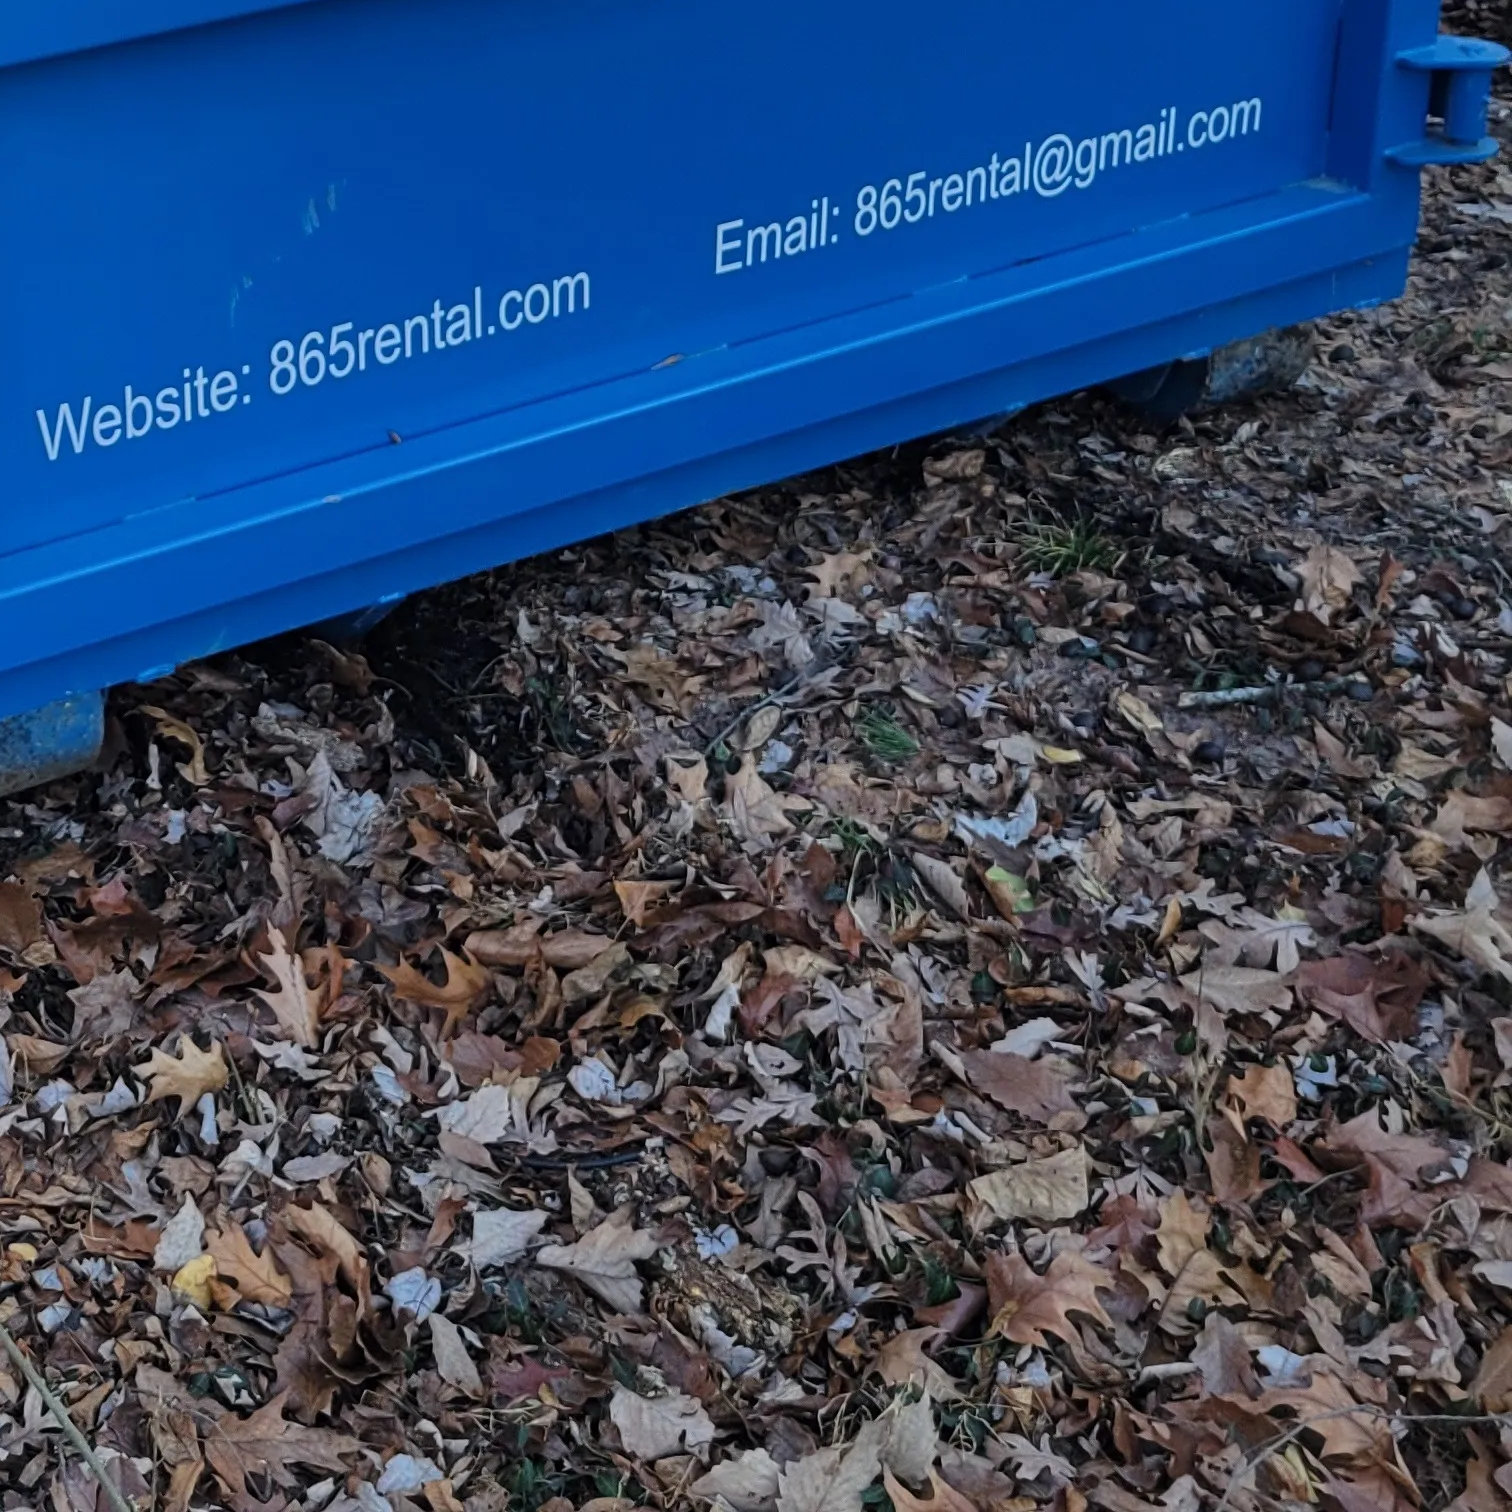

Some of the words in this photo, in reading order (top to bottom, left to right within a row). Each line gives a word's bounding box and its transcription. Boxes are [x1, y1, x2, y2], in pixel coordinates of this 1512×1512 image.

[714, 195, 841, 275] Email:
[853, 96, 1263, 237] 865rental@gmail.com
[35, 363, 252, 462] Website:
[268, 270, 591, 396] 865rental.com
